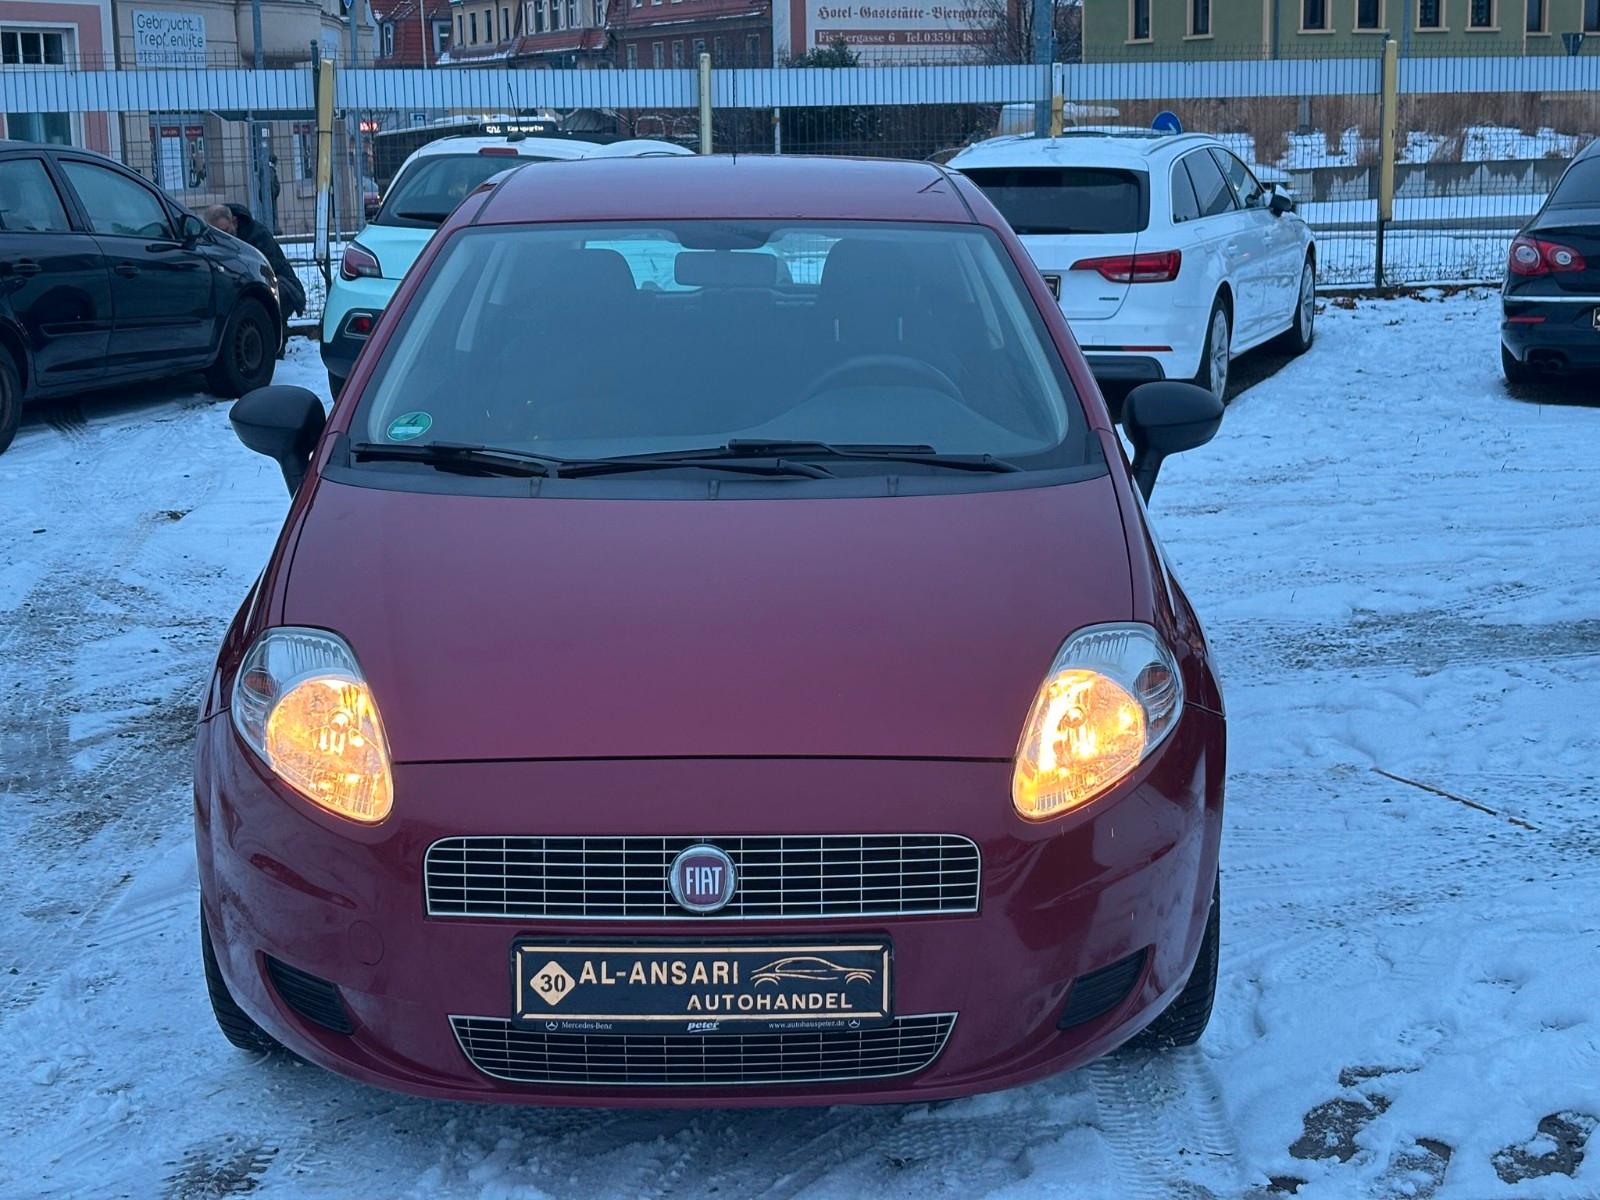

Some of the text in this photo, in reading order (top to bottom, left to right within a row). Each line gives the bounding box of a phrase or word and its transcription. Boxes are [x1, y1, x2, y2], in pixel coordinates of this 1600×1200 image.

[888, 32, 896, 42] 6
[685, 866, 722, 895] FIAT
[540, 960, 739, 993] 30 AL-ANSARI
[687, 992, 853, 1011] AUTOHANDEL
[561, 1021, 613, 1030] Mercedes-Benz
[687, 1020, 720, 1032] peter
[768, 1019, 845, 1029] www.autohauspeter.de
